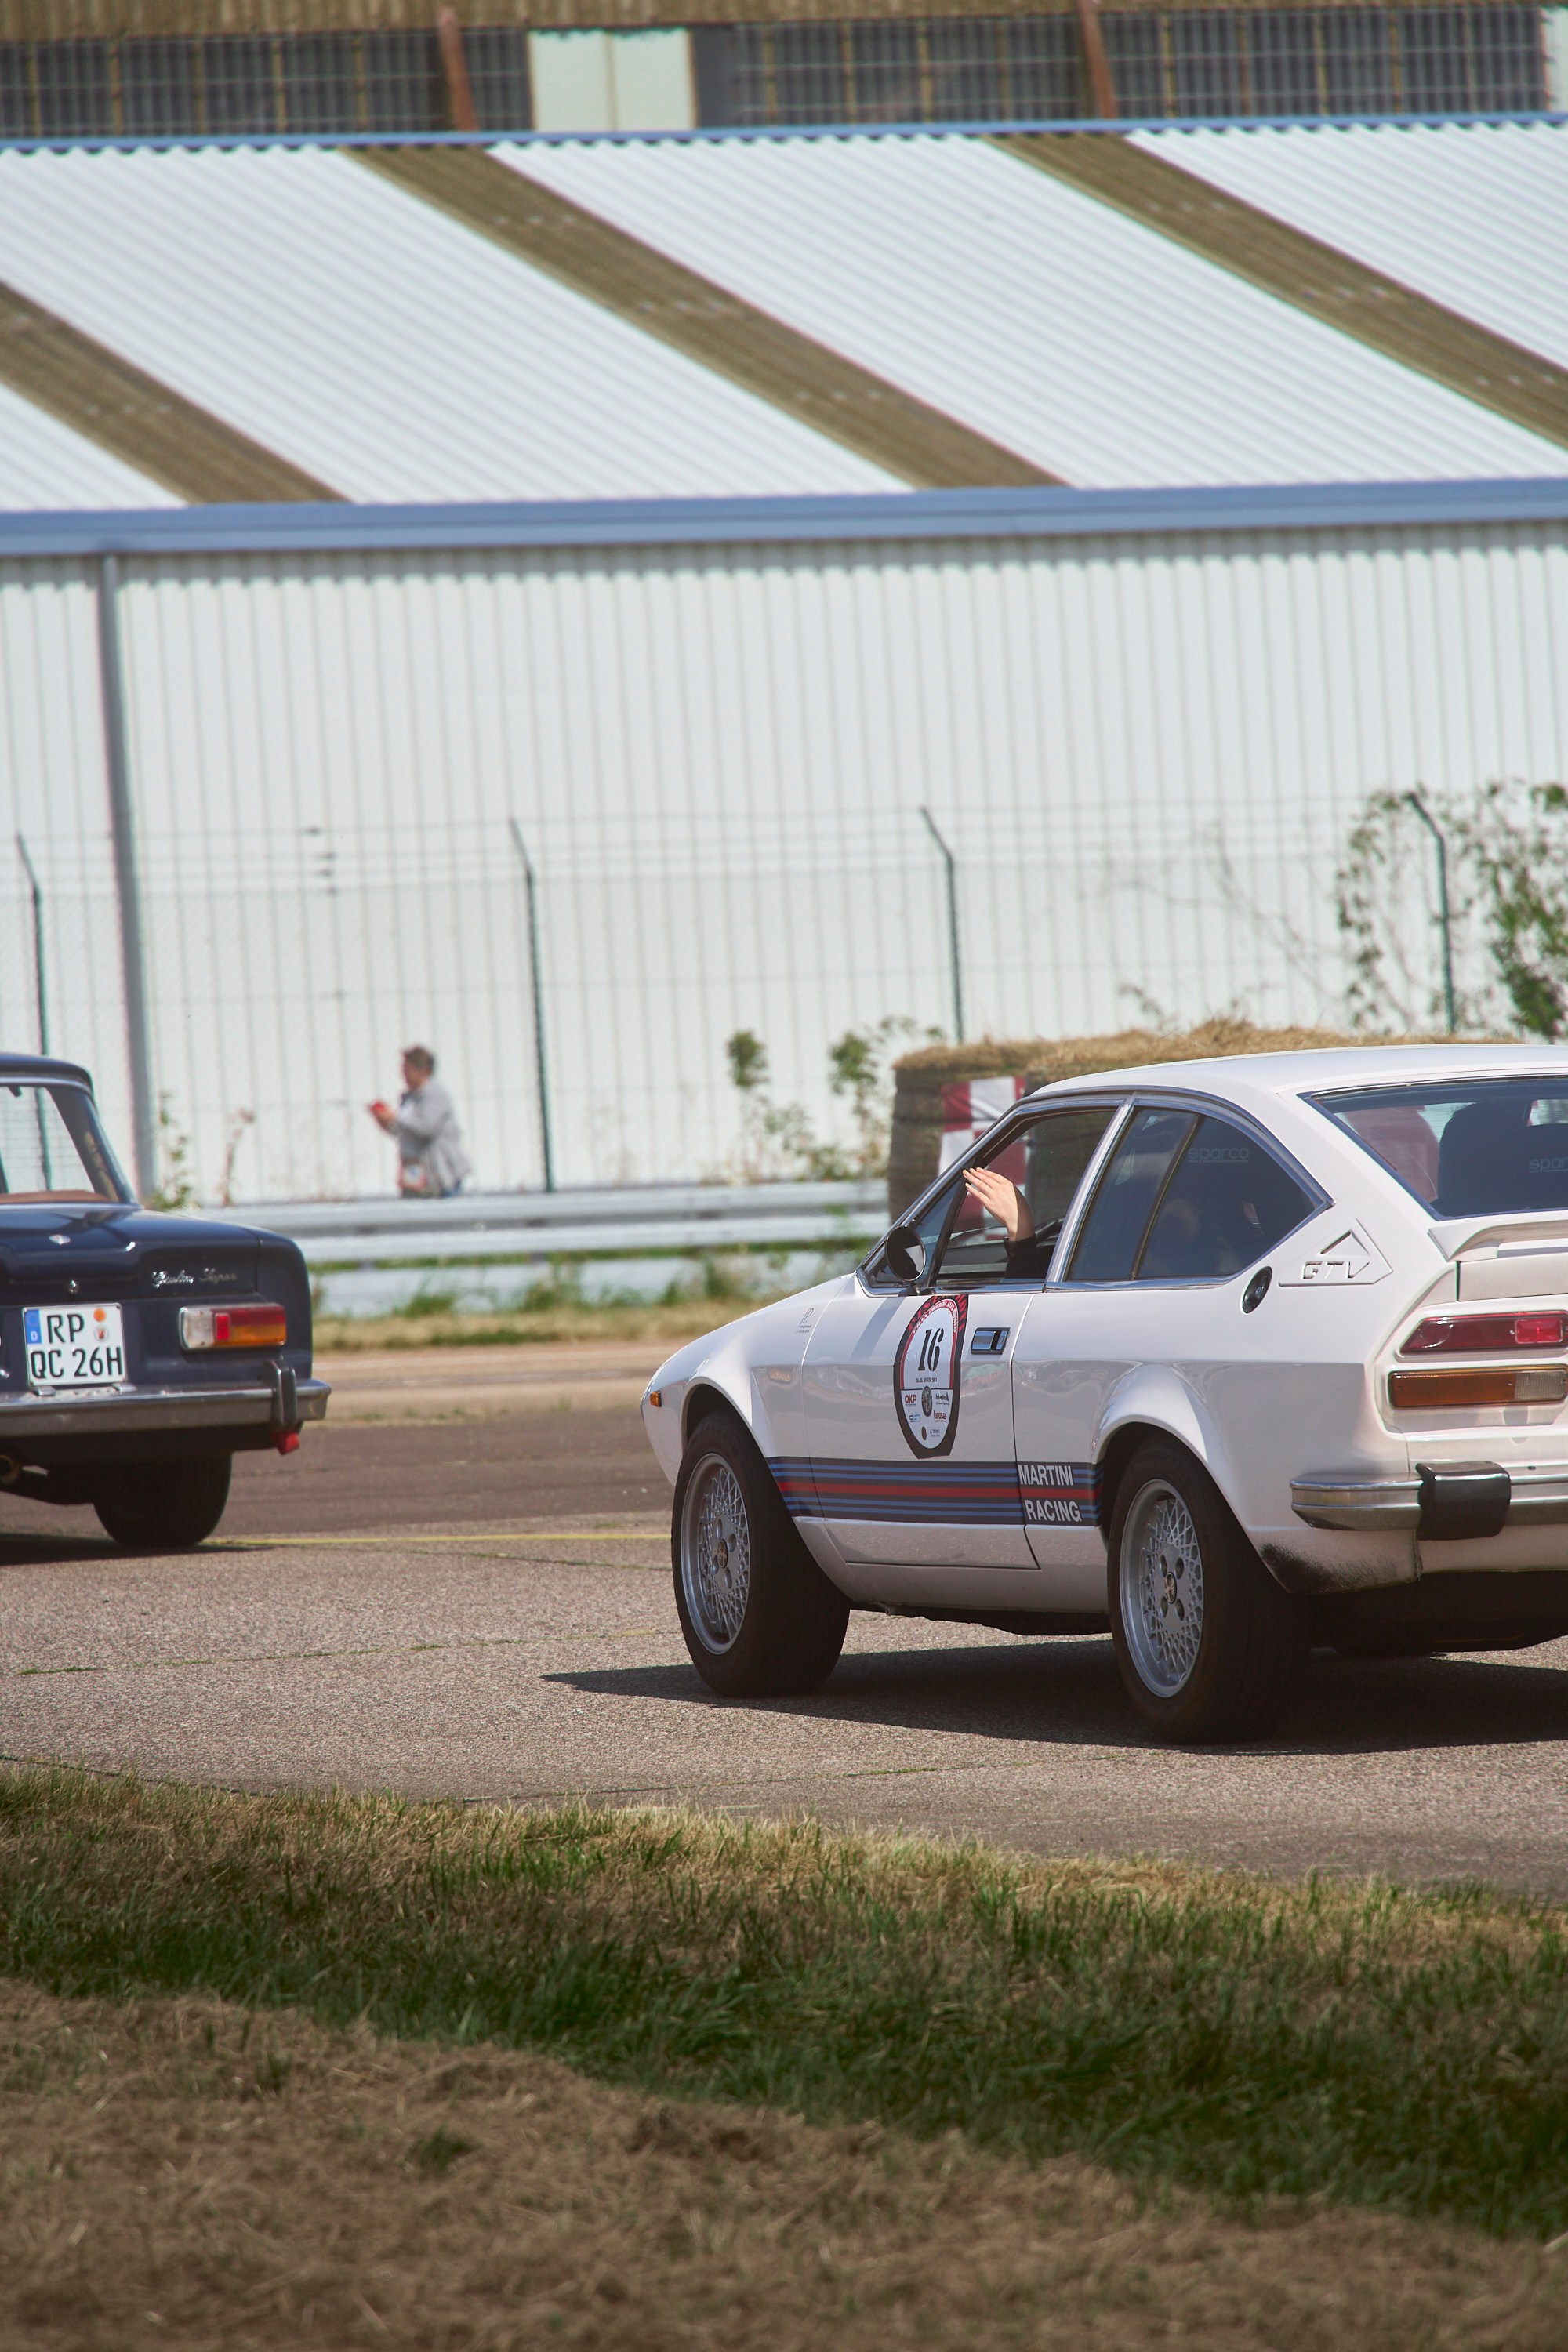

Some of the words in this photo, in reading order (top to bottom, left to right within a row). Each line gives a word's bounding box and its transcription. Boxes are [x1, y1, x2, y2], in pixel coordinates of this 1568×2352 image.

[1188, 1147, 1250, 1163] sparco
[1301, 1261, 1370, 1279] GTV
[31, 1330, 38, 1341] D
[47, 1313, 85, 1343] RP
[918, 1327, 944, 1372] 16
[31, 1349, 64, 1379] QC
[72, 1346, 123, 1377] 26H
[904, 1394, 917, 1403] OKP
[1018, 1465, 1074, 1486] MARTINI
[1024, 1499, 1082, 1523] RACING
